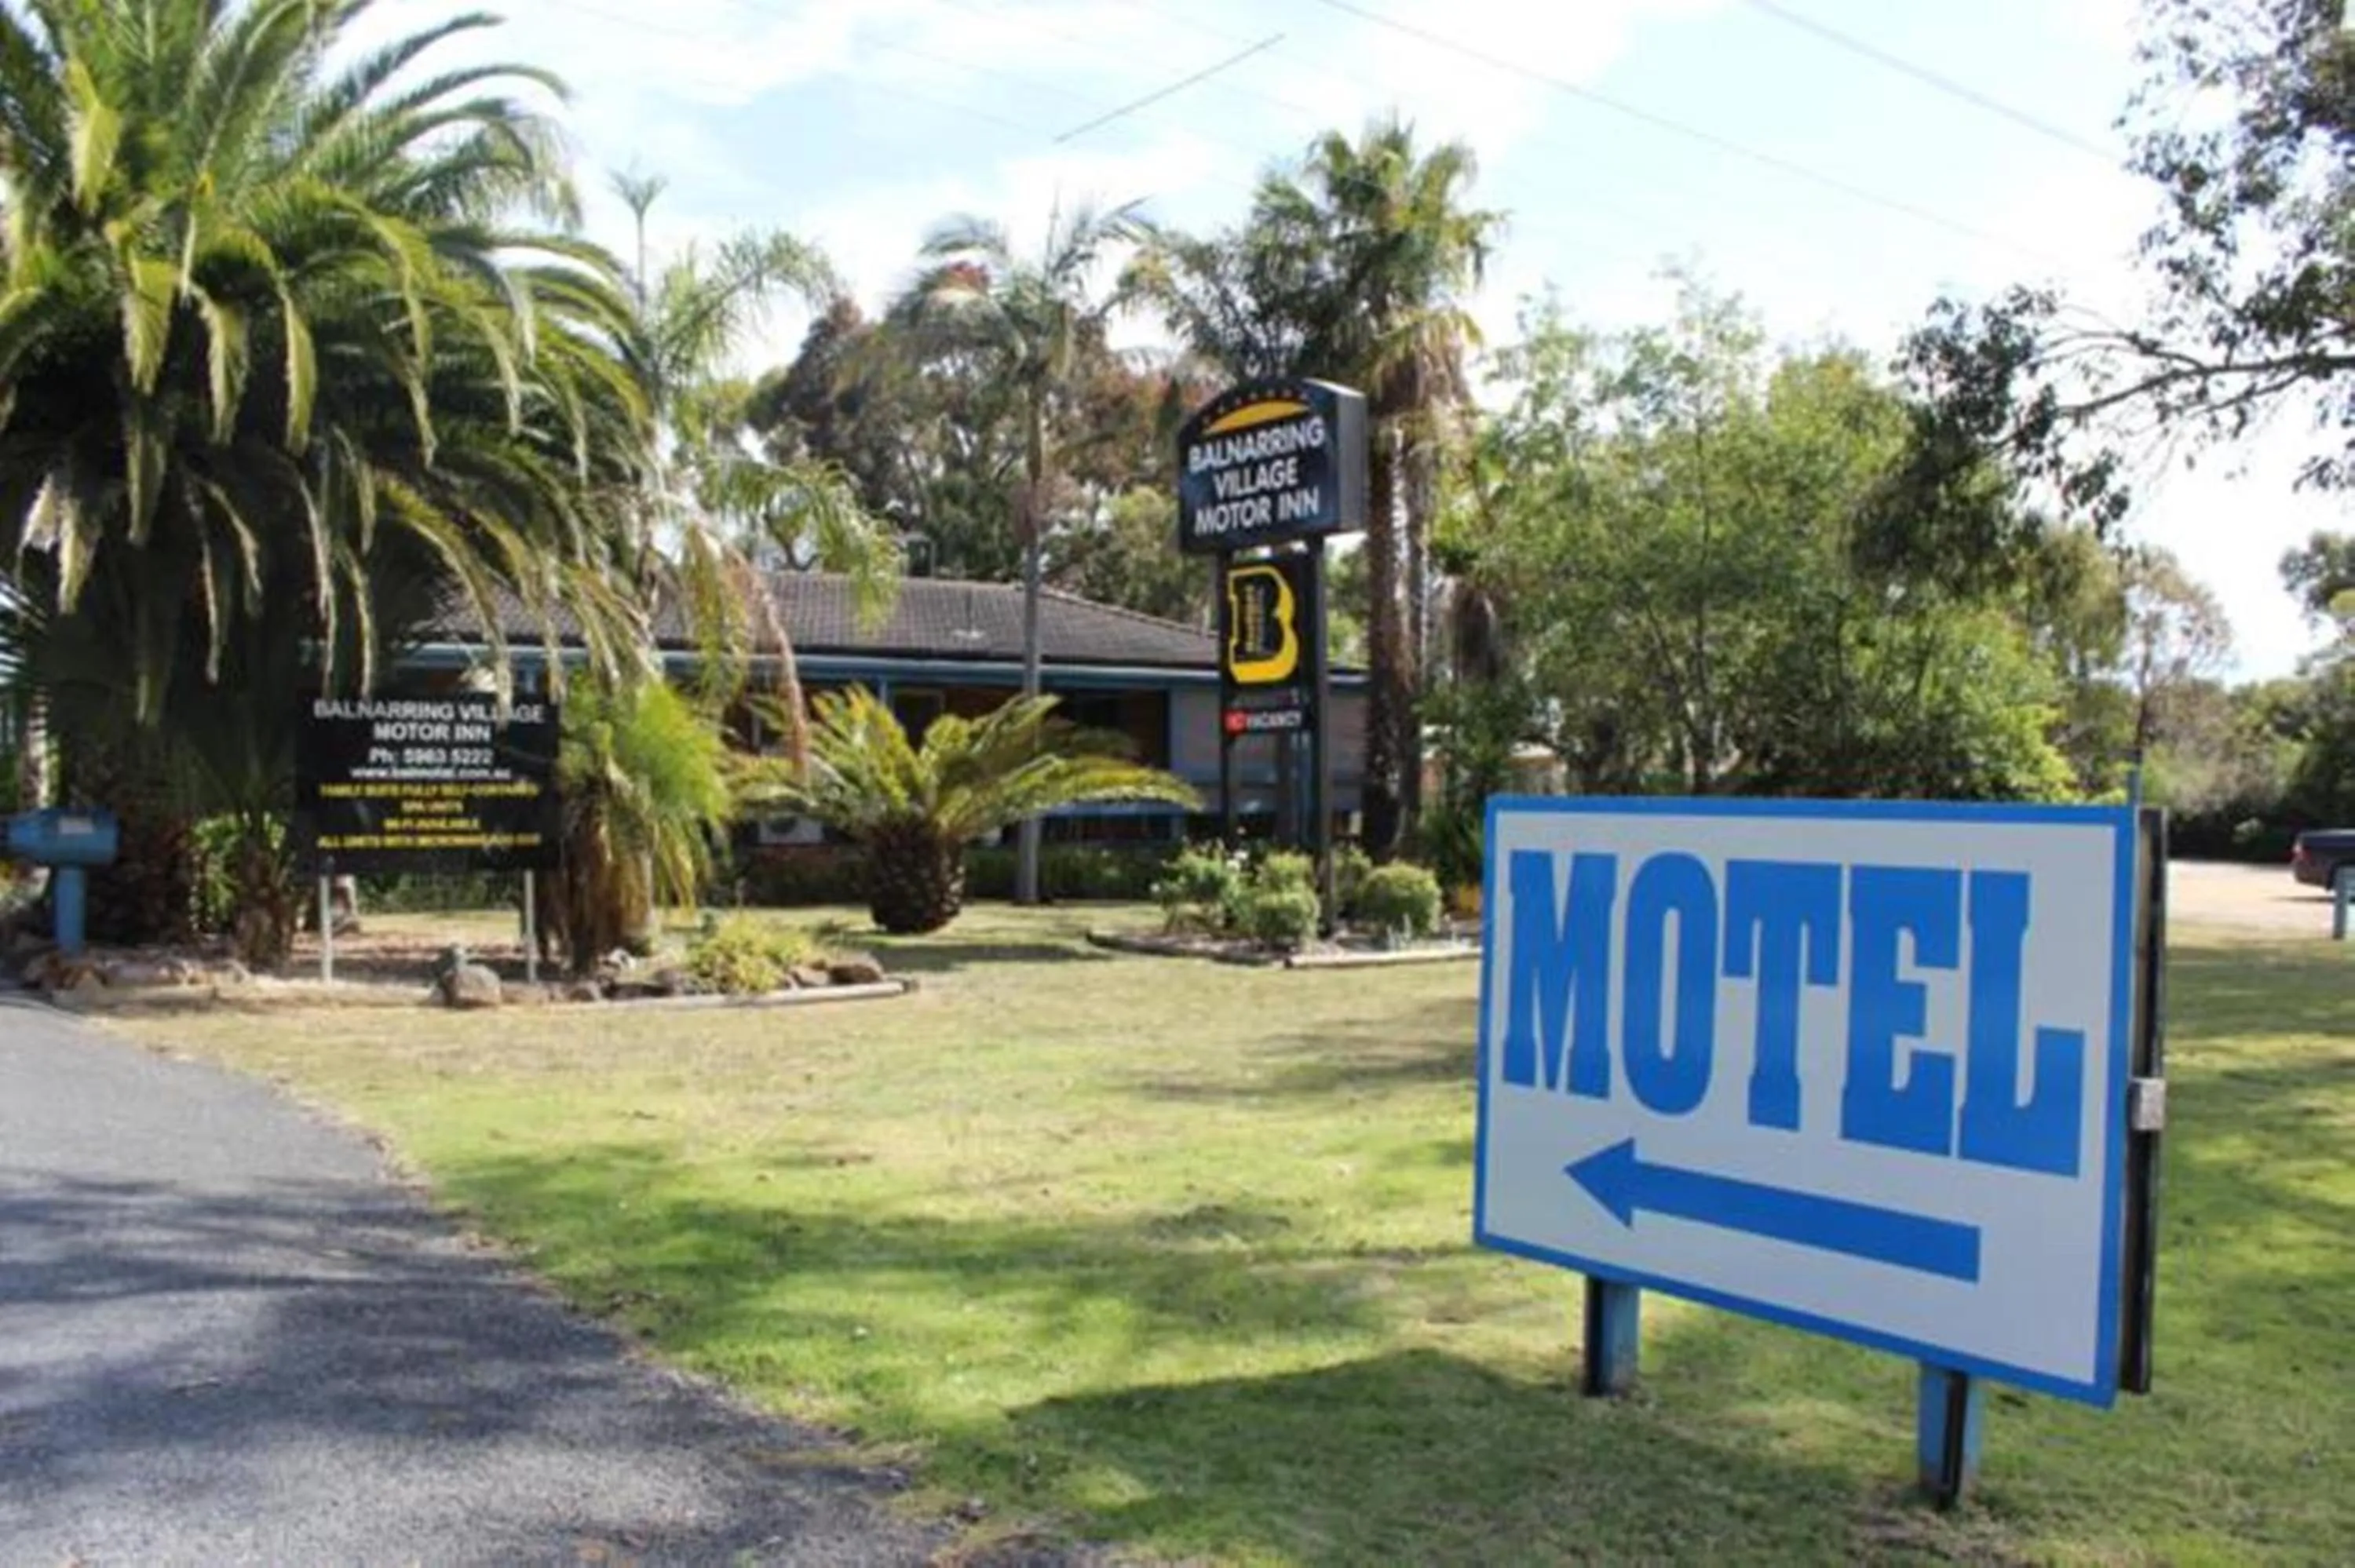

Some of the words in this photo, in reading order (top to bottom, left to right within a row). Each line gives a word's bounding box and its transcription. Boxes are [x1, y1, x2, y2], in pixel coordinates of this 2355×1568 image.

[1188, 416, 1325, 474] BALNARRING
[1213, 457, 1299, 500] VILLAGE
[1194, 496, 1272, 537] MOTOR
[1277, 487, 1320, 521] INN
[314, 699, 455, 720] BALNARRING
[373, 721, 450, 741] MOTOR
[454, 723, 491, 741] INN
[1502, 848, 2085, 1179] MOTEL
